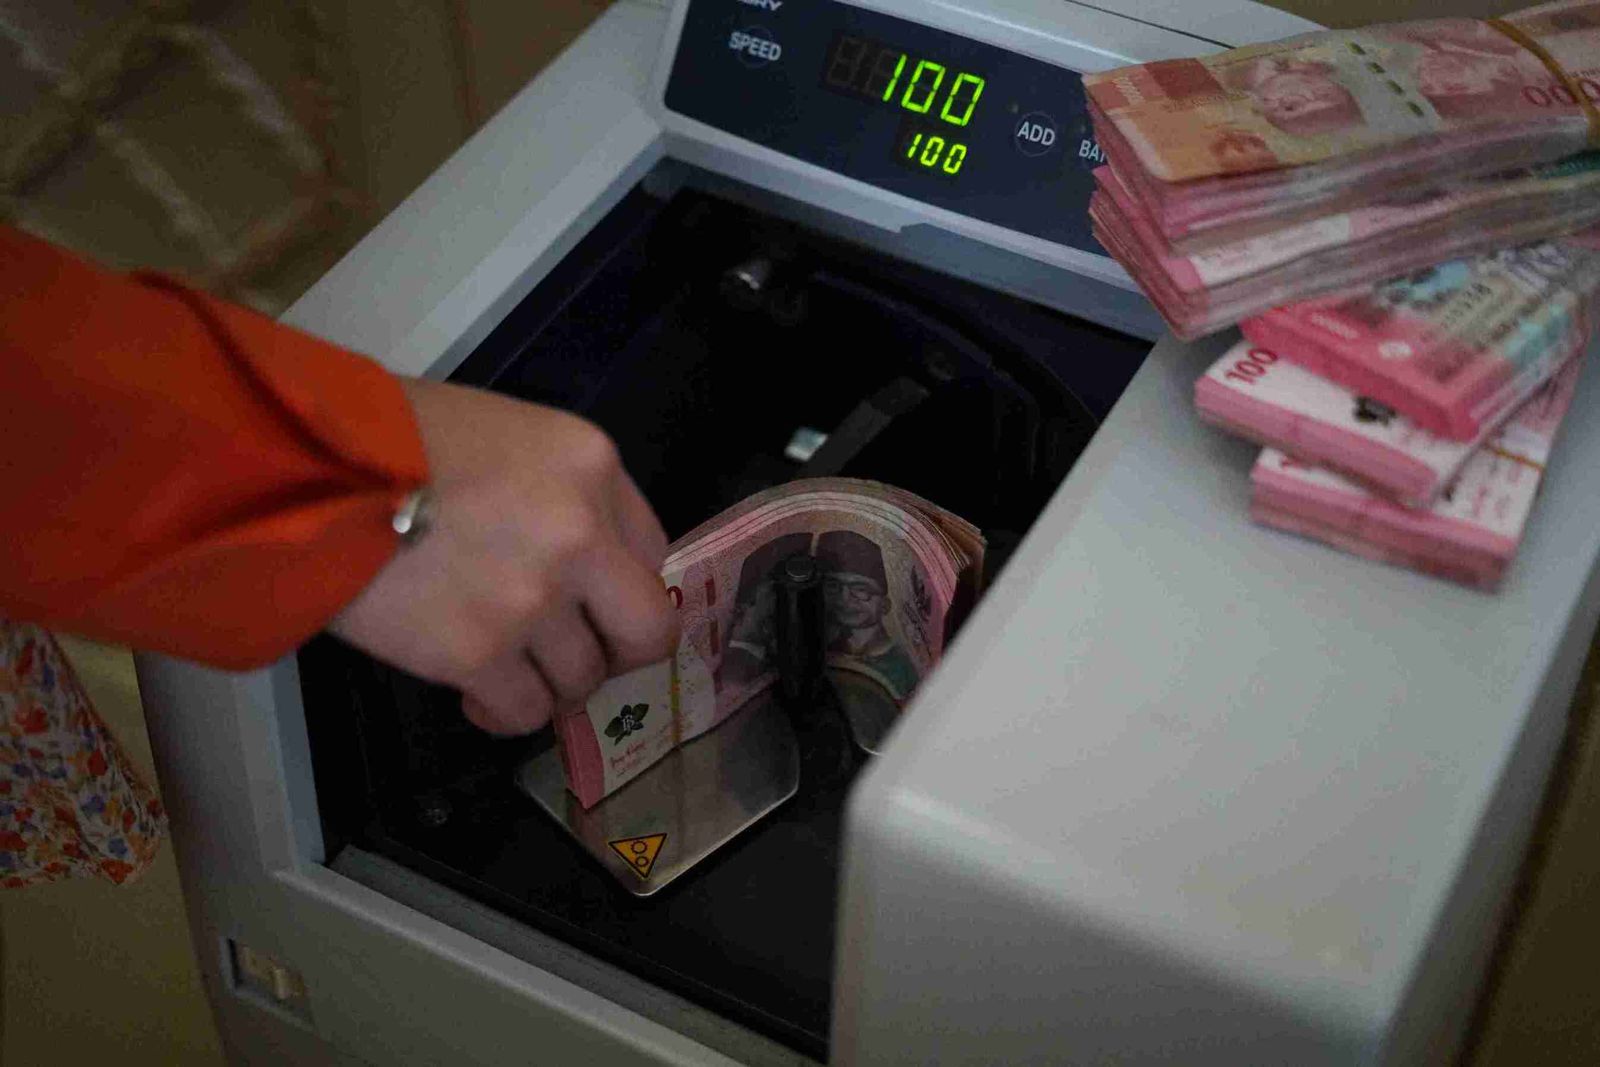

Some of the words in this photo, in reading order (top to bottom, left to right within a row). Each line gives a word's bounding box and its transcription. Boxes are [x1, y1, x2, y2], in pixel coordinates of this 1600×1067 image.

[729, 30, 782, 63] SPEED
[881, 52, 987, 127] 100
[1016, 120, 1056, 147] ADD
[906, 132, 968, 175] 100
[1224, 348, 1278, 385] 100
